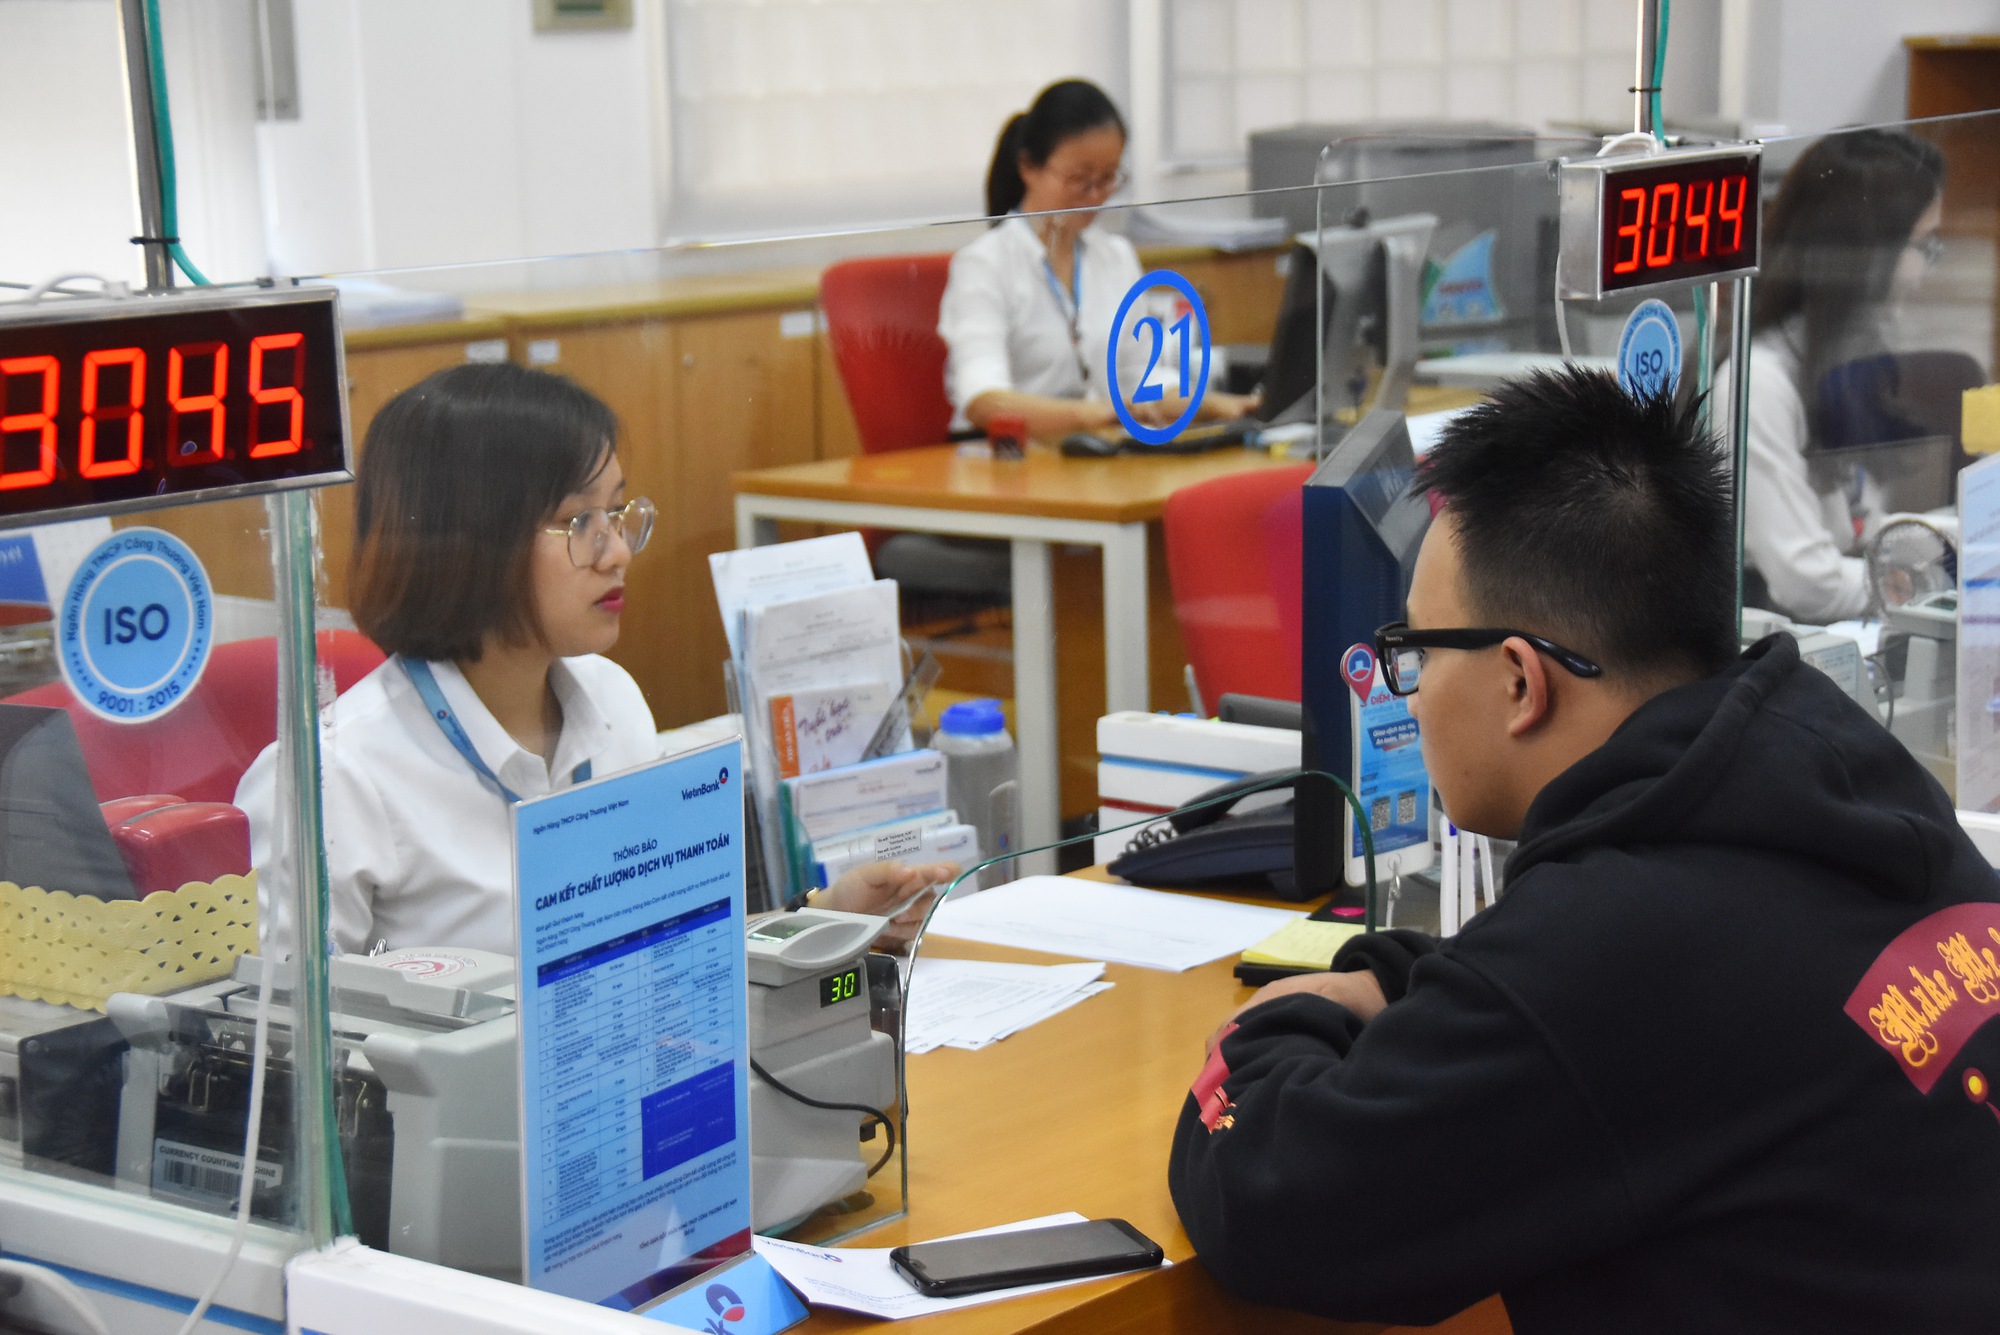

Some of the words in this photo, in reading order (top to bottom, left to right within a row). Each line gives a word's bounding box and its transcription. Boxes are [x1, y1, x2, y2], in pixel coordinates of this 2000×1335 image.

[1613, 175, 1747, 275] 3044
[1132, 311, 1192, 404] 21
[1636, 349, 1663, 376] ISO
[0, 332, 305, 490] 3045
[92, 543, 122, 568] TMCP
[104, 603, 169, 645] ISO
[97, 690, 134, 713] 9001
[147, 681, 181, 710] 2015
[681, 777, 720, 801] VietinBank
[613, 845, 640, 862] THÔNG
[642, 839, 657, 853] BÁO
[536, 892, 557, 911] CAM
[559, 882, 576, 903] KẾT
[578, 873, 601, 896] CHẤT
[604, 866, 636, 888] LƯỢNG
[638, 857, 660, 877] DỊCH
[661, 853, 674, 869] VỤ
[675, 842, 704, 862] THANH
[706, 833, 729, 852] TOÁN
[831, 971, 856, 1002] 30
[159, 1146, 199, 1161] CURRENCY
[200, 1154, 240, 1169] COUNTING
[242, 1161, 276, 1177] CHINE
